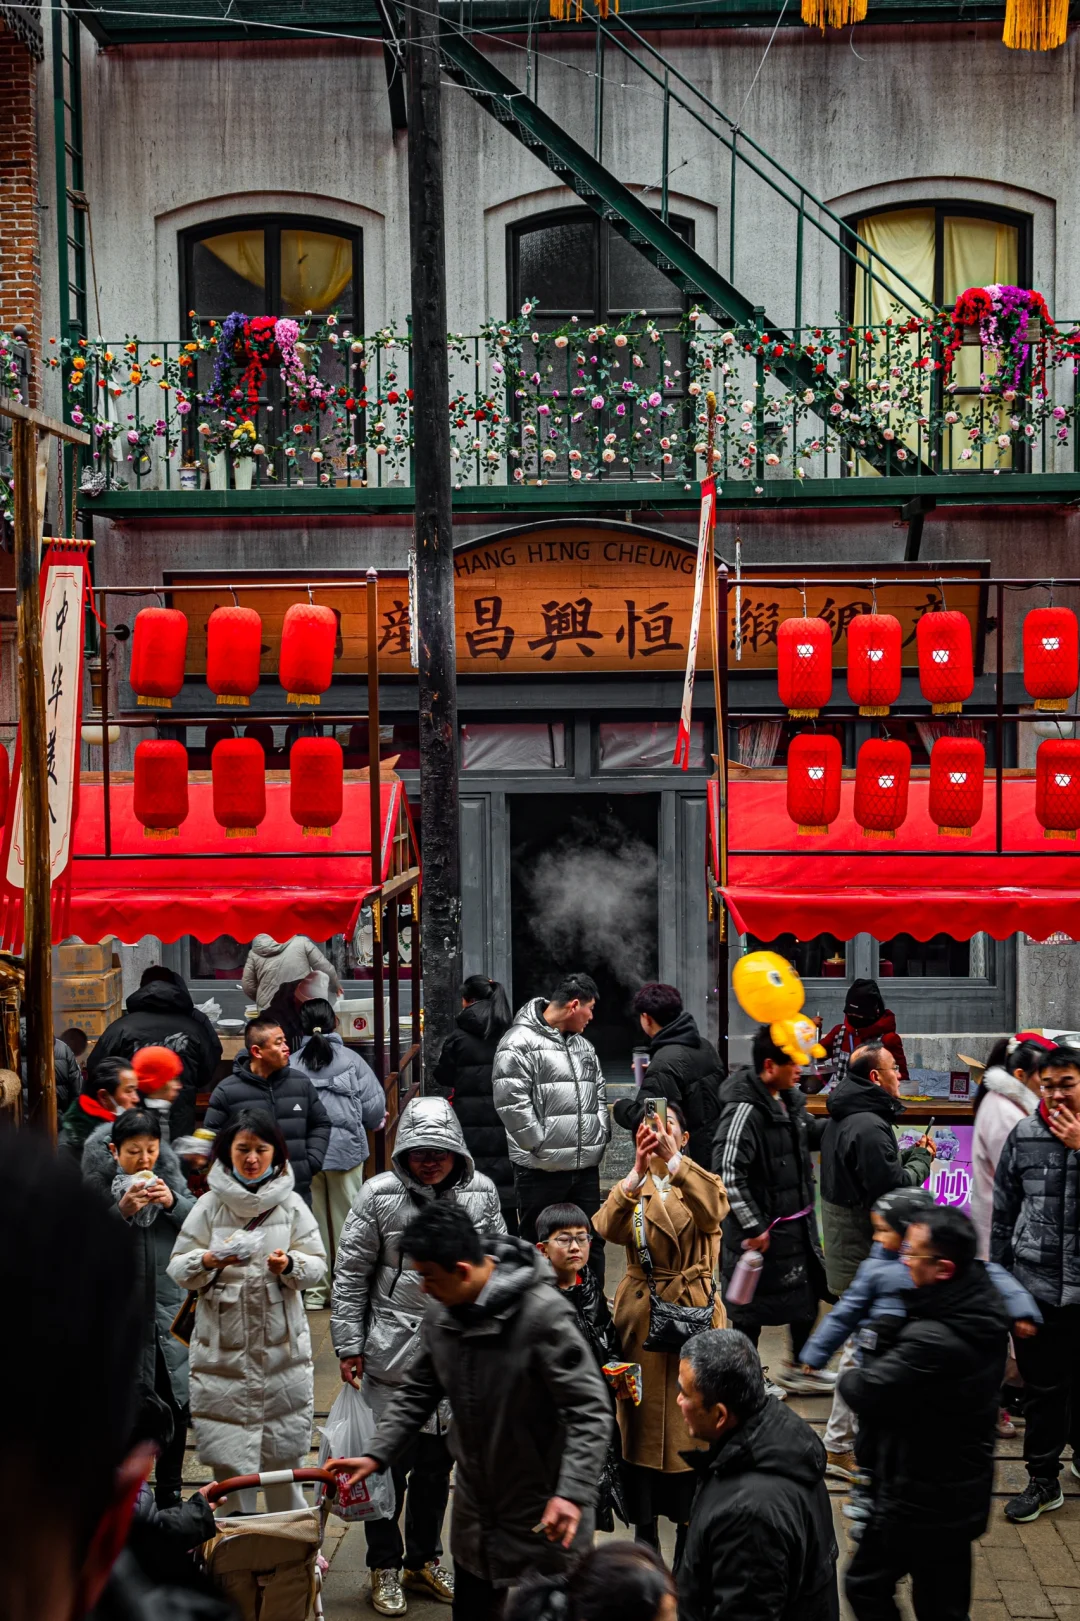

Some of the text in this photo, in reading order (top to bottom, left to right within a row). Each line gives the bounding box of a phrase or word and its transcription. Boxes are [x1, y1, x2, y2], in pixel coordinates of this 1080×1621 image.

[453, 541, 696, 577] HANG HING CHEUNG
[934, 1170, 973, 1207] 炒
